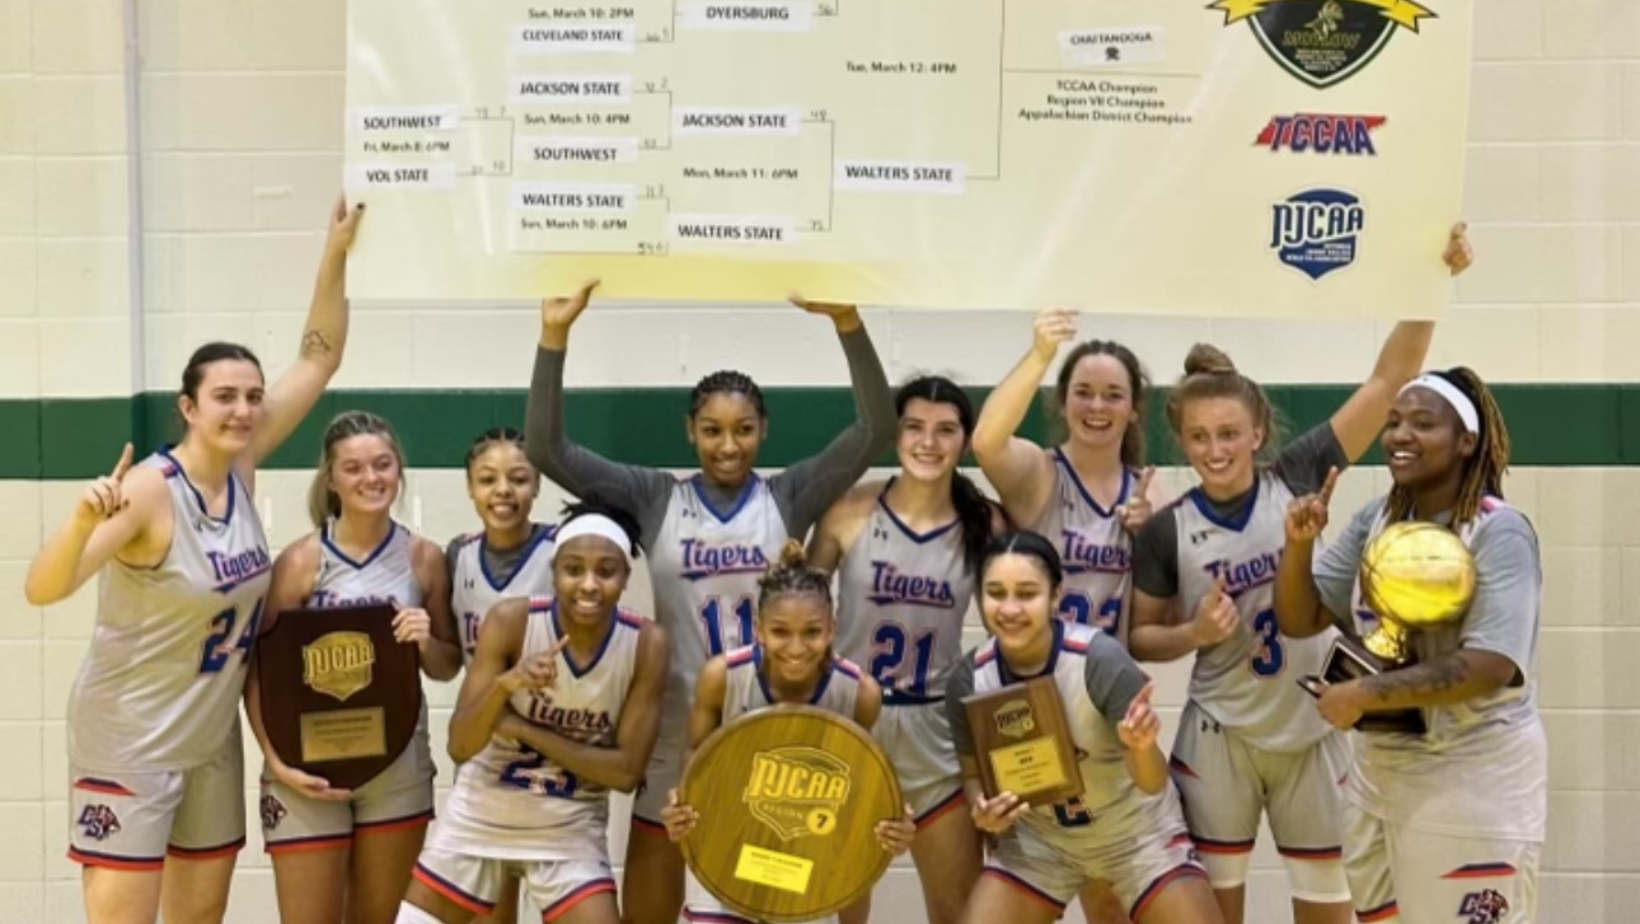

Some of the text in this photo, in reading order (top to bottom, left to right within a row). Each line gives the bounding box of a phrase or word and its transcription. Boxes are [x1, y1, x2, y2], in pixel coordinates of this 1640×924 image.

[528, 8, 634, 20] Sun, March 10: 2PM
[706, 6, 789, 20] DYERSBURG
[523, 30, 623, 42] CLEVELAND STATE
[1070, 31, 1153, 46] CHATTANOOGA
[846, 61, 957, 74] Tue, March 12: 4PM
[520, 83, 620, 95] JACKSON STATE
[1057, 79, 1158, 95] TCCAA Champion
[1047, 94, 1087, 107] Region
[1106, 96, 1165, 109] Champion
[364, 116, 441, 129] SOUTHWEST
[524, 113, 630, 125] Sun, March 10: 4PM
[683, 114, 787, 128] JACKSON STATE
[1018, 108, 1192, 125] Appalachian District Champion
[1270, 115, 1377, 156] TCCAA
[381, 142, 413, 152] March
[533, 147, 617, 161] SOUTHWEST
[367, 169, 428, 183] VOL STATE
[683, 167, 711, 180] Mon,
[714, 168, 746, 179] March
[771, 168, 798, 180] 6PM
[845, 165, 953, 182] WALTERS STATE
[522, 194, 625, 208] WALTERS STATE
[521, 218, 543, 230] Sun,
[546, 219, 581, 230] March
[602, 219, 627, 230] 6PM
[1270, 203, 1364, 248] NJCAA
[678, 225, 783, 241] WALTERS STATE
[680, 538, 768, 572] Tigers
[1062, 529, 1130, 569] Tiger
[205, 544, 268, 582] Tigers
[1204, 549, 1284, 588] Tiger
[870, 561, 955, 602] Tigers
[701, 597, 755, 656] 11
[199, 596, 263, 674] 24
[1251, 607, 1284, 676] 3
[870, 623, 936, 698] 21
[528, 688, 610, 729] Tigers
[749, 757, 847, 799] NJCAA
[816, 812, 828, 829] 7
